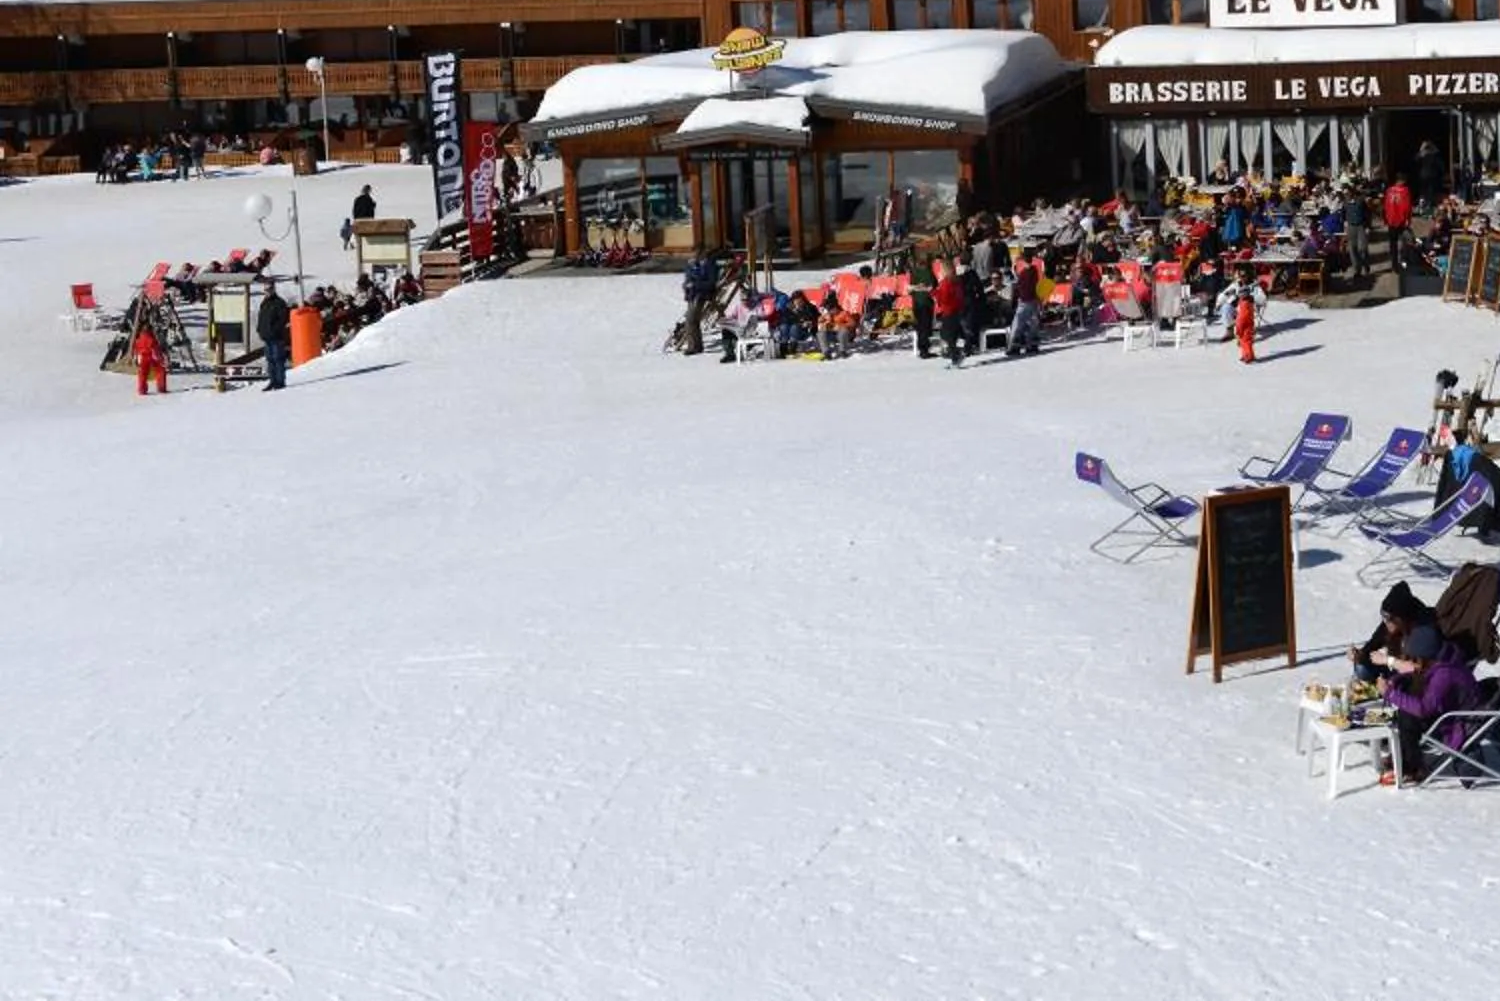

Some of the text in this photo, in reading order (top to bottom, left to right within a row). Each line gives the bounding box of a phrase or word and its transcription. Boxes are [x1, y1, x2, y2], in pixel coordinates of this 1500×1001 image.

[1109, 80, 1248, 104] BRASSERIE
[1275, 78, 1308, 100] LE
[1317, 76, 1381, 98] VEGA
[427, 52, 464, 193] BURTON
[617, 114, 649, 129] SHOP
[923, 119, 957, 130] SHOP
